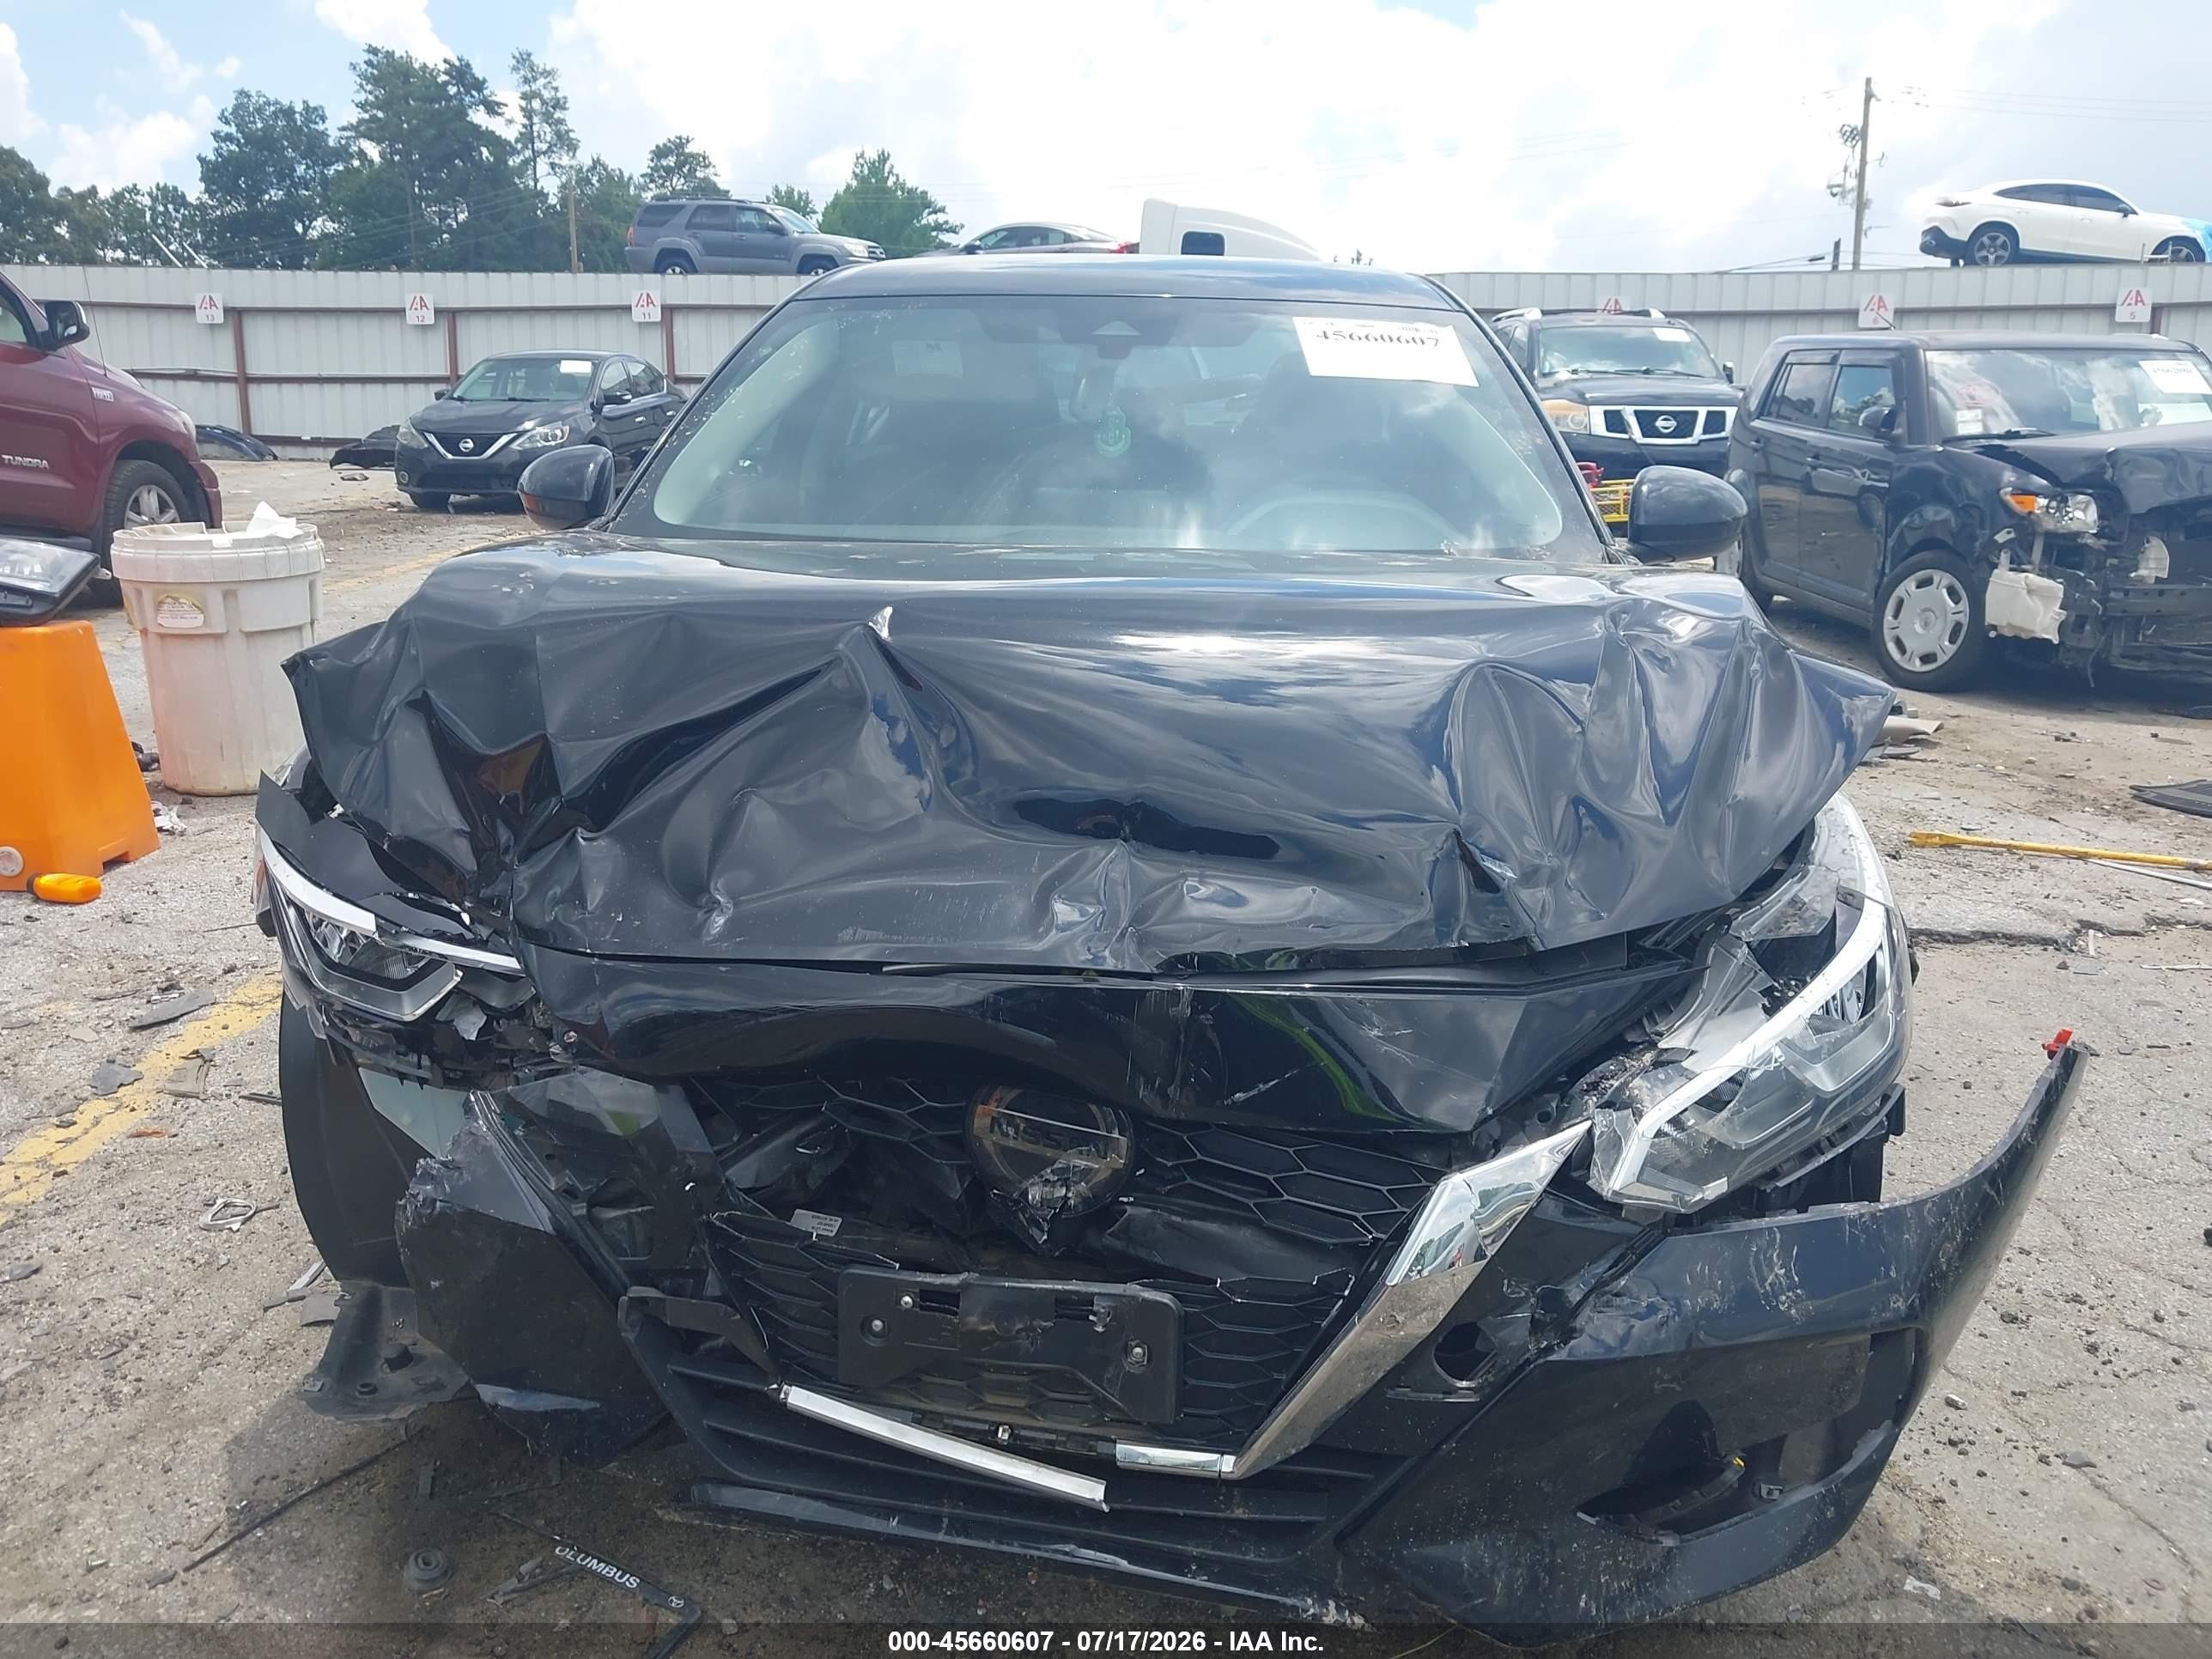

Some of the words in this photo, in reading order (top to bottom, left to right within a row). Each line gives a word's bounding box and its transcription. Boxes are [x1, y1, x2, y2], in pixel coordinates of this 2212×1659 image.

[2130, 311, 2136, 320] 5
[1, 454, 50, 469] TUNDRA
[554, 1537, 641, 1589] OLUMBUS
